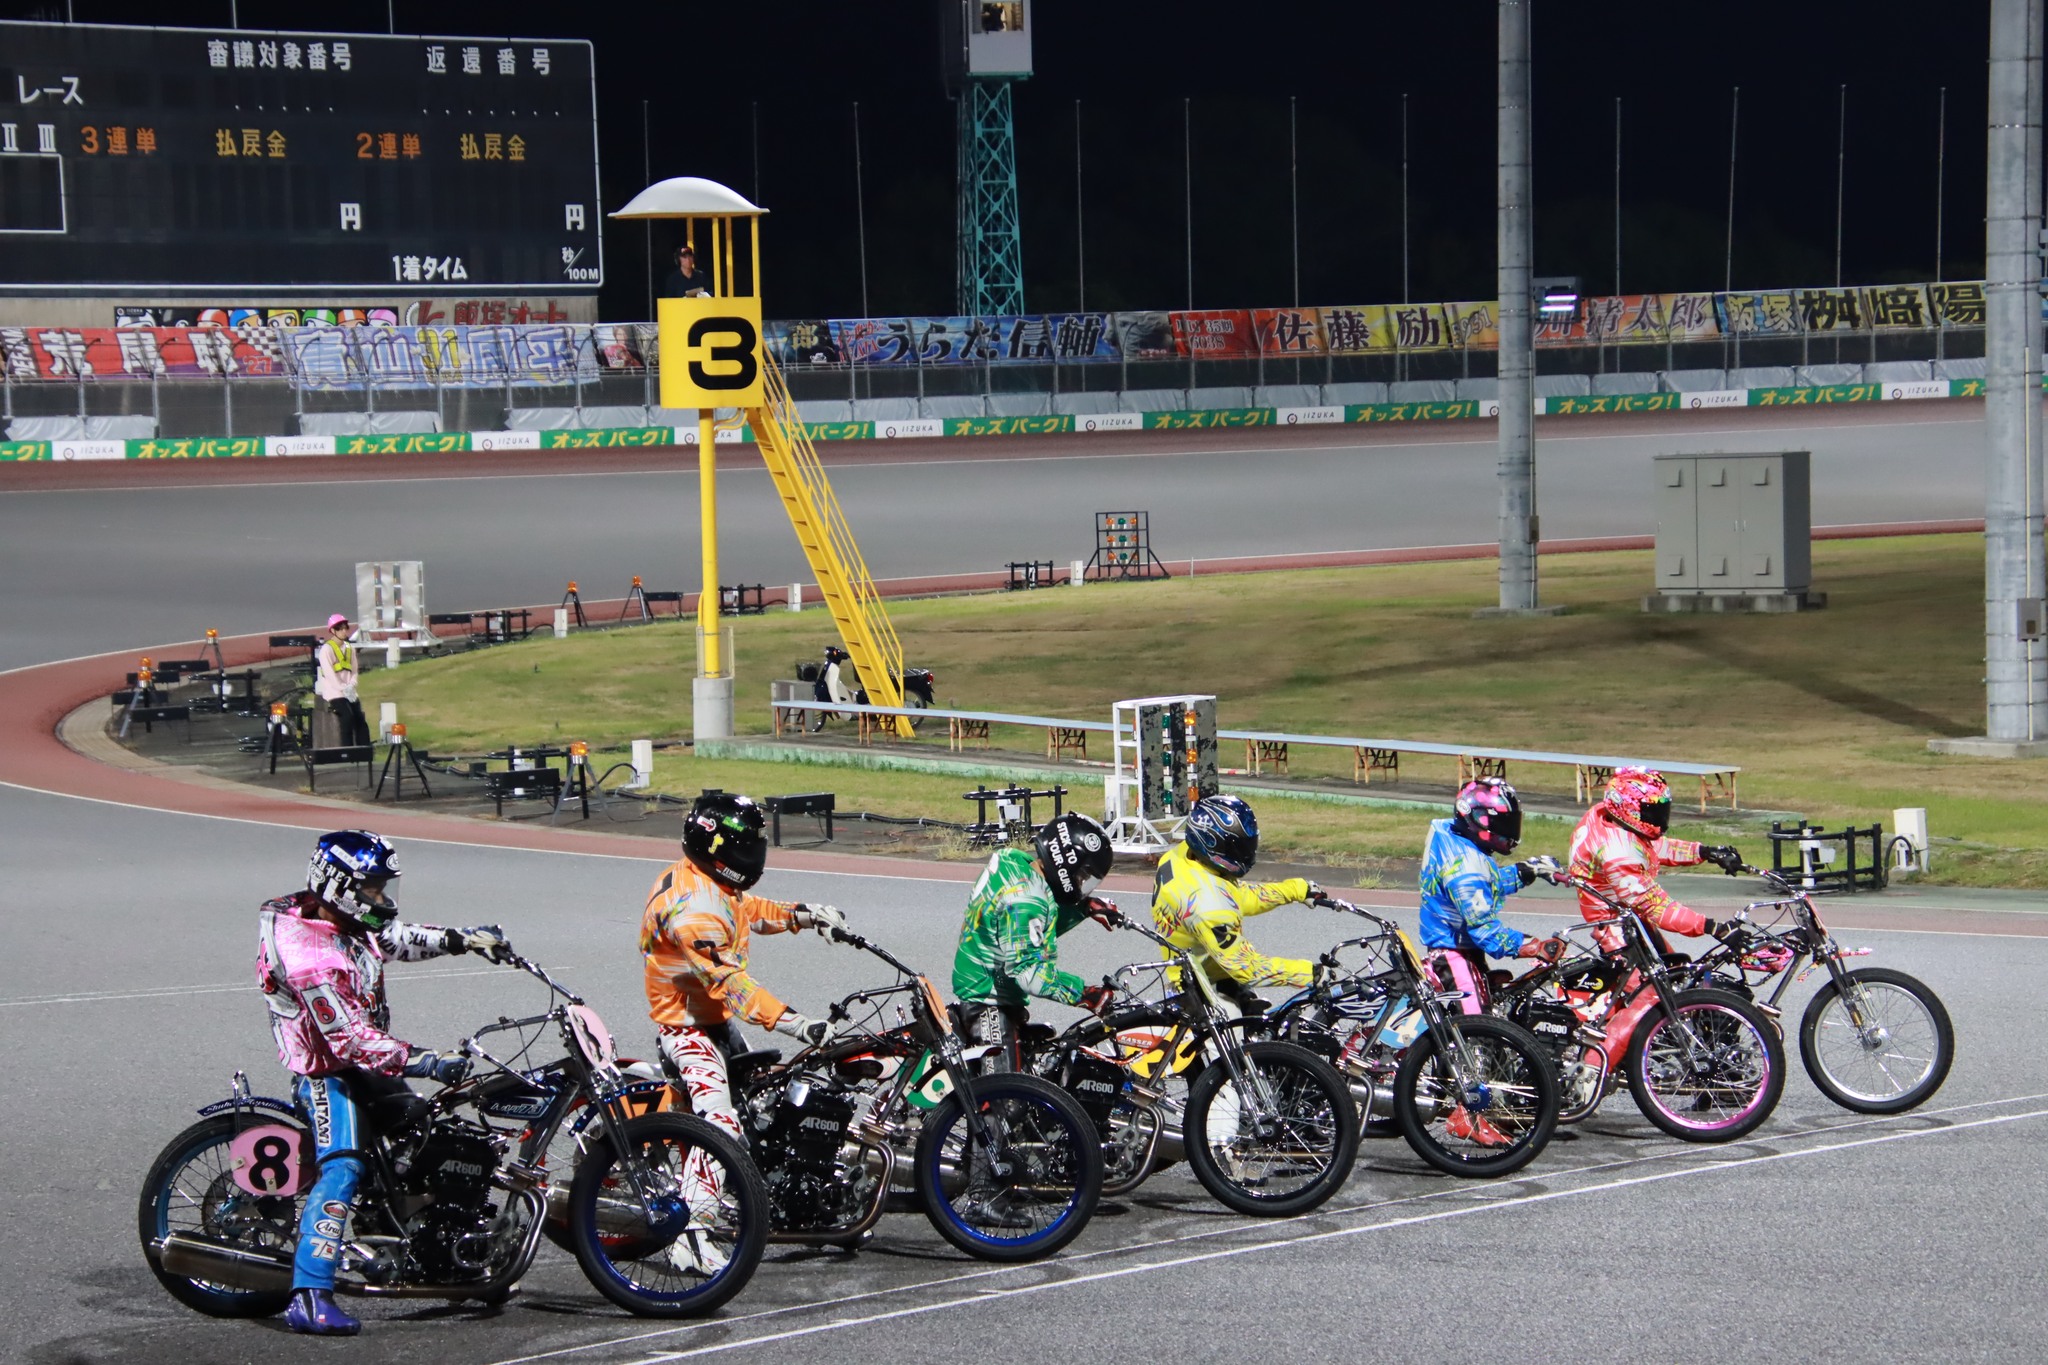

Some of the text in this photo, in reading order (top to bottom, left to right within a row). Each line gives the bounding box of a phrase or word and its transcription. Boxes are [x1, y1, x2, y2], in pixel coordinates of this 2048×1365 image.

[208, 40, 351, 71] 審議対象番号
[427, 46, 550, 76] 返還番号
[18, 75, 83, 105] レース
[81, 126, 157, 154] 3連単
[215, 128, 286, 158] 払戻金
[356, 132, 421, 160] 2連単
[460, 133, 526, 161] 払戻金
[340, 203, 361, 230] 円
[565, 204, 585, 231] 円
[392, 255, 468, 281] 1着タイム
[1273, 306, 1441, 352] 佐藤励
[688, 316, 757, 390] 3
[1057, 821, 1078, 865] STICK TO
[1048, 837, 1074, 893] YOUR GUNS
[311, 996, 337, 1024] 8
[1120, 1035, 1153, 1046] KASSER
[1532, 1021, 1568, 1035] AR600
[1076, 1079, 1114, 1095] AR600
[798, 1116, 840, 1132] AR600
[248, 1136, 291, 1192] 8
[438, 1160, 483, 1176] AR600
